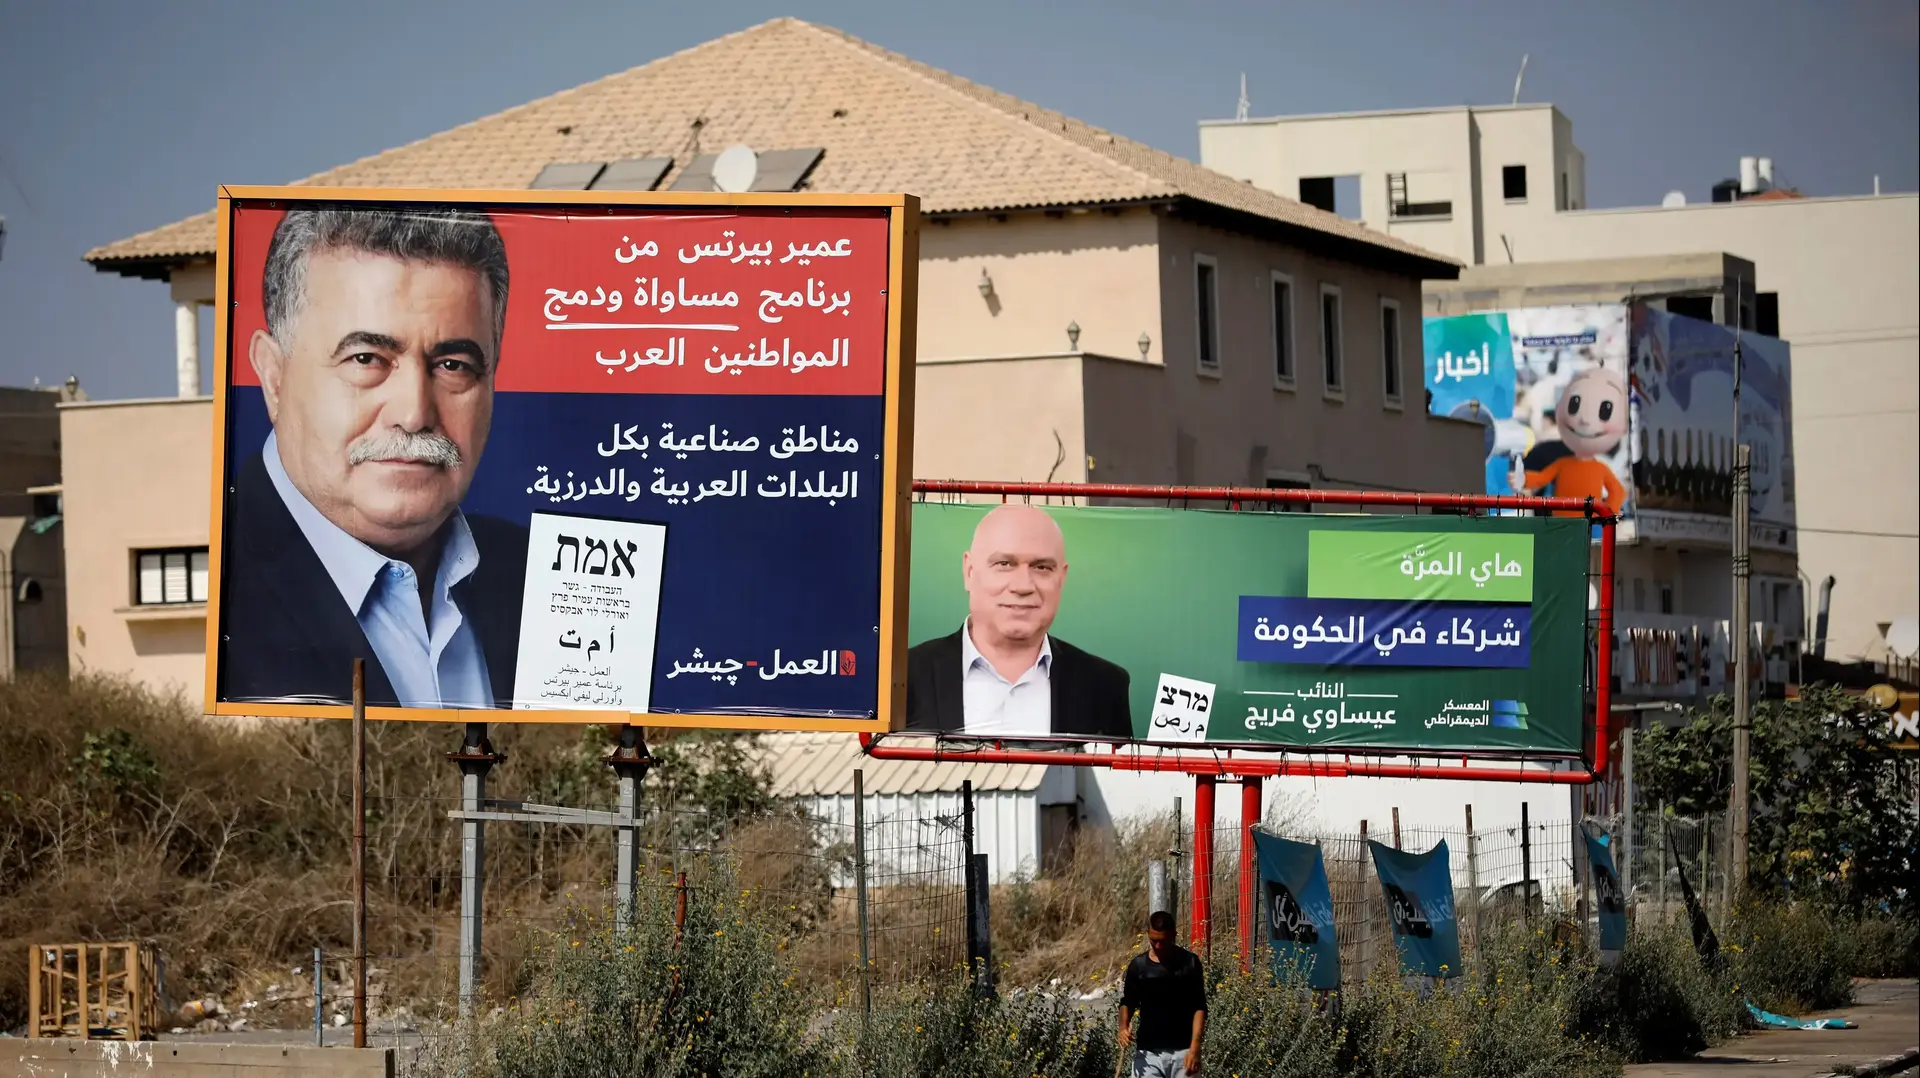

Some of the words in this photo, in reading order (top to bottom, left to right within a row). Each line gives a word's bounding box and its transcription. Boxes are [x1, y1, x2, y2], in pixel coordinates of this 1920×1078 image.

[615, 235, 660, 264] من
[678, 230, 773, 266] بيرتس
[779, 238, 853, 266] عمير
[543, 285, 624, 322] ودمج
[633, 276, 740, 313] مساواة
[758, 277, 851, 323] برنامج
[595, 336, 686, 375] العرب
[704, 337, 850, 376] المواطنين
[1434, 342, 1490, 384] أخبار
[597, 422, 651, 460] بكل
[658, 422, 761, 460] صناعية
[769, 424, 860, 459] مناطق
[526, 465, 641, 503] والدرزية.
[650, 467, 748, 505] العربية
[757, 470, 858, 507] البلدات
[551, 533, 638, 579] אמת
[1469, 552, 1522, 588] هاي
[551, 592, 569, 602] פרץ
[562, 581, 580, 591] גשר
[572, 595, 593, 605] עמיר
[590, 584, 623, 596] העבודה
[596, 597, 631, 608] בראשות
[550, 604, 583, 616] אבקסיס
[586, 607, 599, 617] לוי
[602, 610, 630, 620] ואורלי
[1254, 615, 1365, 650] الحكومة
[1374, 620, 1427, 657] في
[1436, 617, 1521, 653] شركاء
[1160, 685, 1209, 712] מרצ
[1297, 682, 1344, 701] النائب
[1442, 699, 1490, 712] المعسكر
[1244, 702, 1295, 730] فريج
[1302, 701, 1397, 734] عيساوي
[1424, 713, 1490, 729] الديمقراطي
